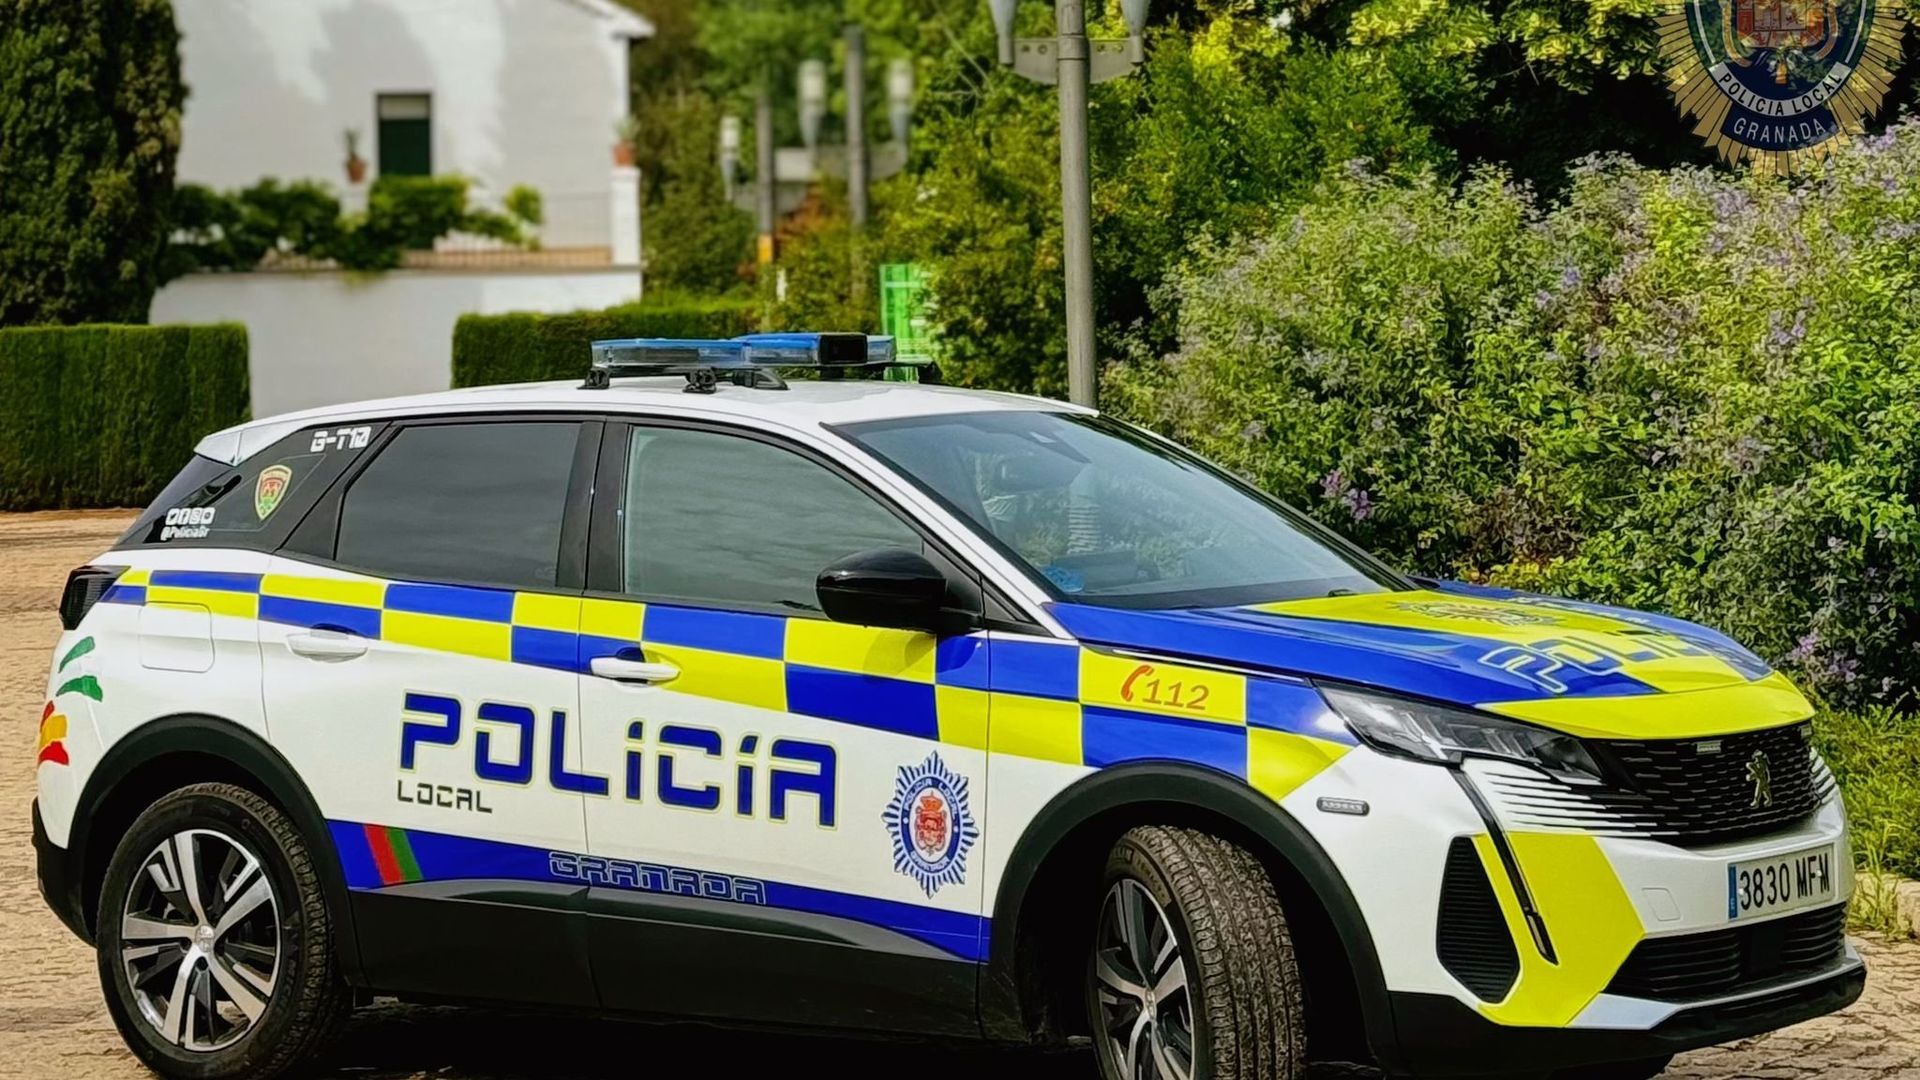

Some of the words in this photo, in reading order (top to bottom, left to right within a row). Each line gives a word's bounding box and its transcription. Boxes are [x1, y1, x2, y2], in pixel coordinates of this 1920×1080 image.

[1142, 678, 1210, 710] 112
[396, 779, 493, 814] LOCAL
[548, 851, 766, 906] GRANADA
[1740, 862, 1790, 911] 3830
